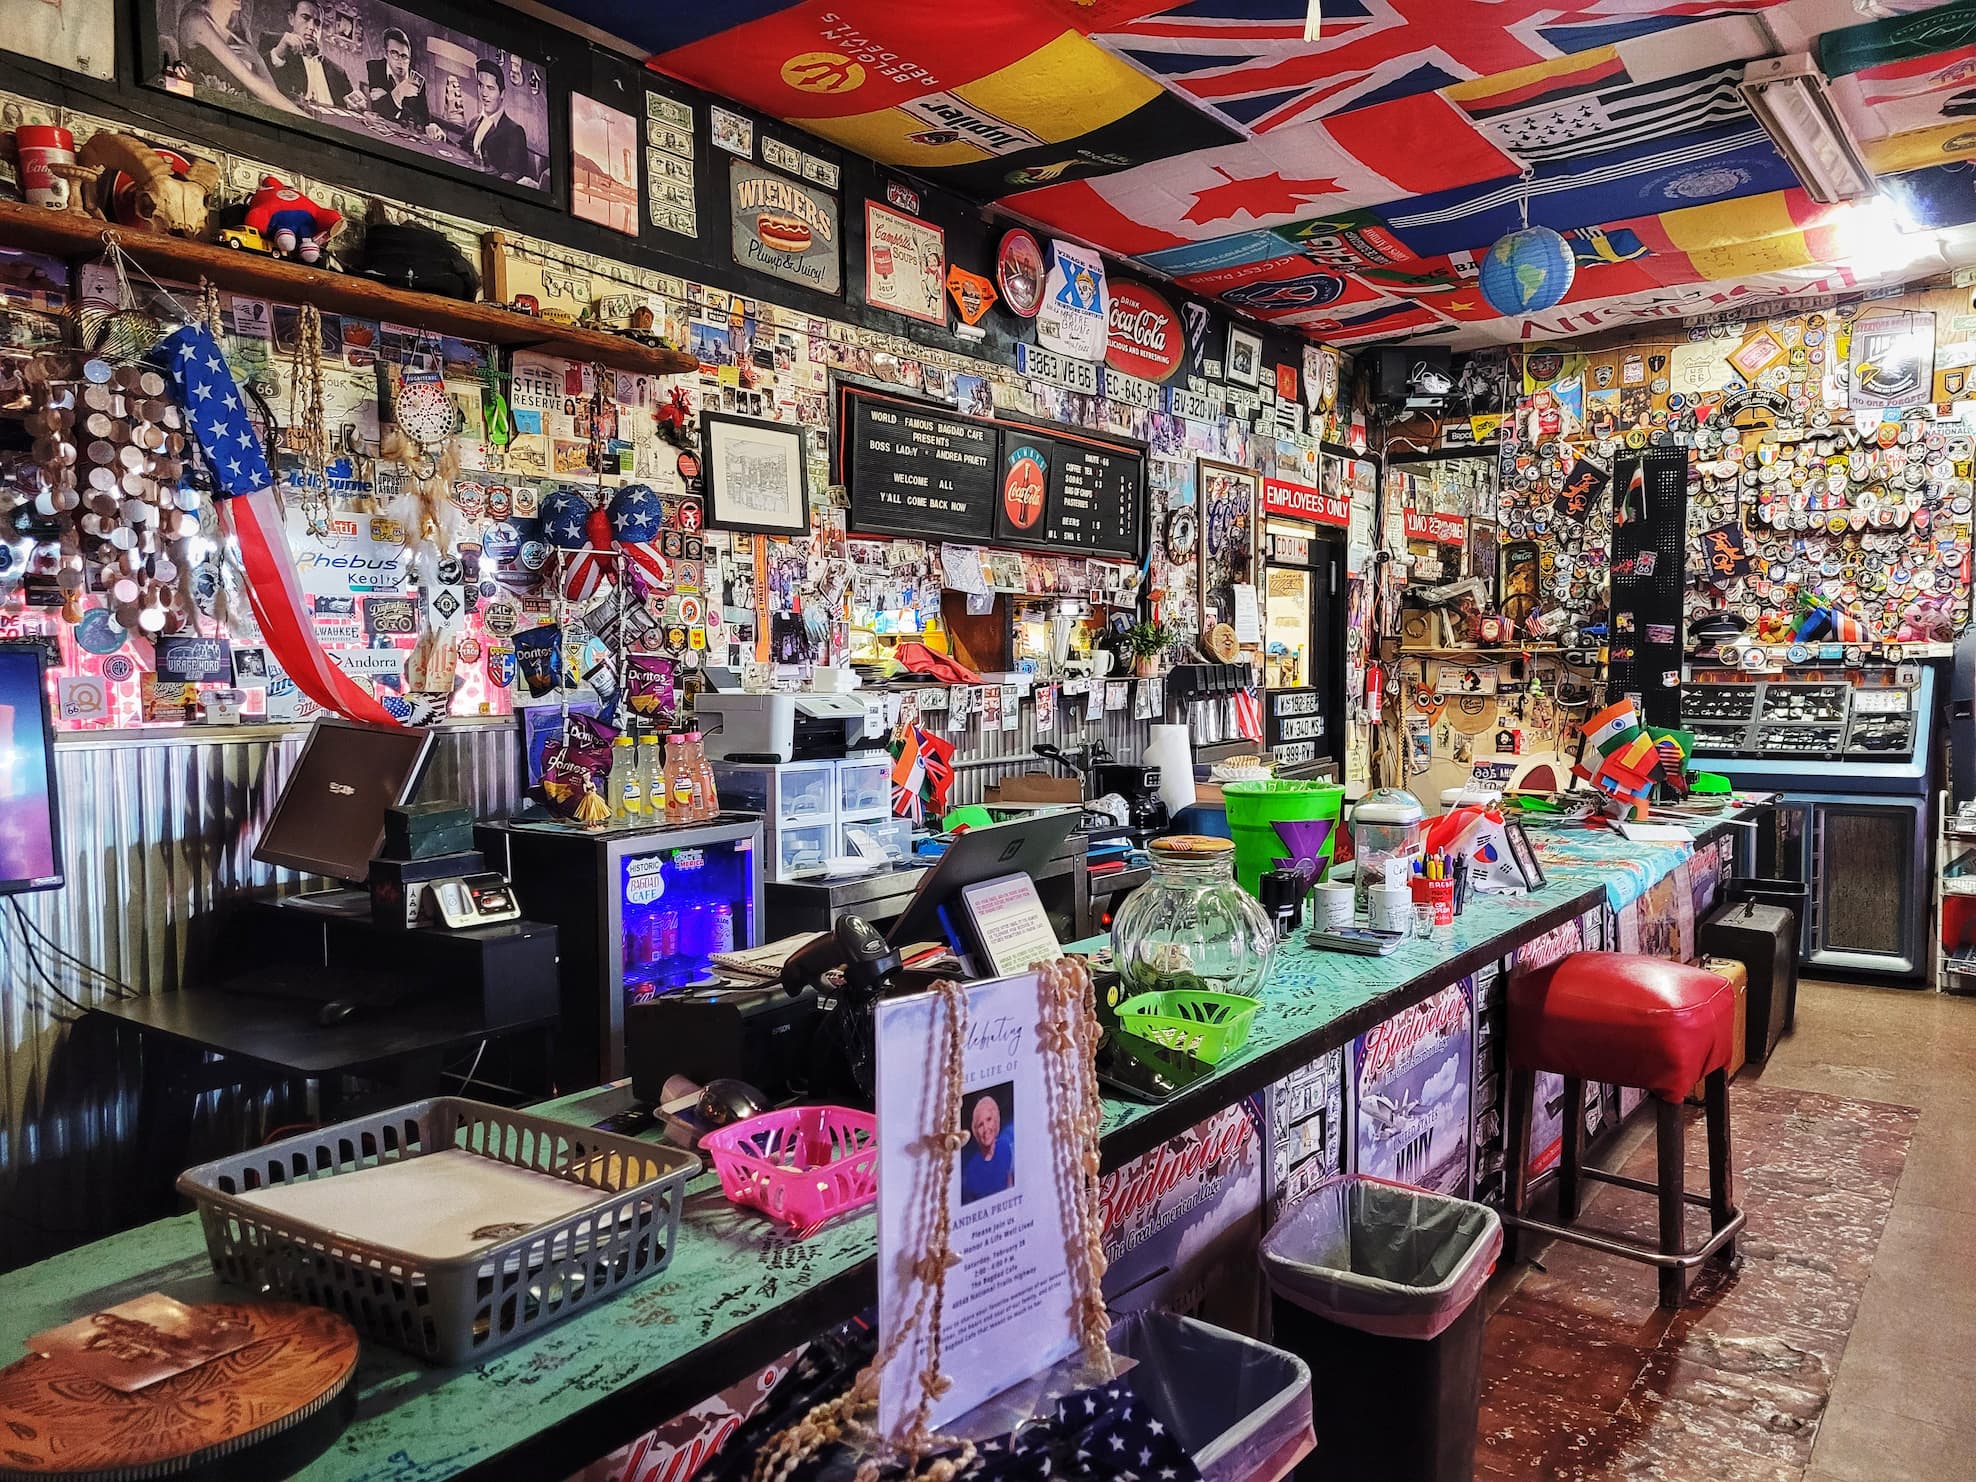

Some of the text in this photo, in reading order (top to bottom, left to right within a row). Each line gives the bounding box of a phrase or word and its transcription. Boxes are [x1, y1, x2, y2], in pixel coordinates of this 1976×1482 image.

[918, 102, 1031, 148] Jupiler
[737, 178, 832, 242] WIENERS
[892, 247, 918, 266] SOUPS
[1120, 296, 1141, 309] DRINK
[1107, 339, 1170, 365] ELICIOUS AND REFRESHING
[256, 383, 274, 396] 66
[514, 376, 561, 398] STEEL
[514, 394, 562, 411] RESERVE
[870, 410, 984, 441] WORLD FAMOUS BAGDAD CAFE
[912, 432, 950, 448] PRESENTS
[869, 440, 988, 467] BOSS LADY ANDREA PRUETT
[1065, 462, 1093, 476] COFFEE TEA
[893, 472, 954, 490] WELCOME ALL
[1065, 474, 1083, 485] SODAS
[880, 492, 967, 513] Y'ALL COME BACK NOW
[1266, 485, 1349, 519] EMPLOYEES ONLY
[1062, 516, 1080, 527] BEERS
[296, 553, 398, 570] Phébus
[349, 573, 400, 585] Keolis
[314, 626, 360, 639] LWAUKEE
[167, 658, 198, 672] VIRAGE
[344, 656, 397, 669] Andorra
[628, 670, 667, 682] Doritos
[68, 707, 79, 715] 66
[629, 861, 660, 872] HISTORIC
[630, 878, 659, 892] BAGDAD
[632, 889, 657, 901] CAFE
[1365, 991, 1467, 1076] Budweiser
[980, 1060, 1019, 1080] LIFE OF
[1393, 1107, 1439, 1151] UNITED STATES
[1396, 1126, 1434, 1186] NAVY
[1100, 1113, 1255, 1234] Budweiser
[952, 1195, 1024, 1232] ANDREA PRUETT
[1106, 1174, 1225, 1264] The Great American Lager
[963, 1242, 983, 1255] Honor
[991, 1234, 1003, 1245] Life
[1004, 1227, 1018, 1240] Well
[1018, 1220, 1034, 1233] Lived
[971, 1227, 992, 1241] Please
[993, 1221, 1006, 1233] Join
[993, 1243, 1018, 1259] February
[970, 1283, 996, 1301] National
[1014, 1266, 1037, 1281] Highway
[983, 1269, 1004, 1285] Bagdad
[1005, 1264, 1018, 1275] Cafe
